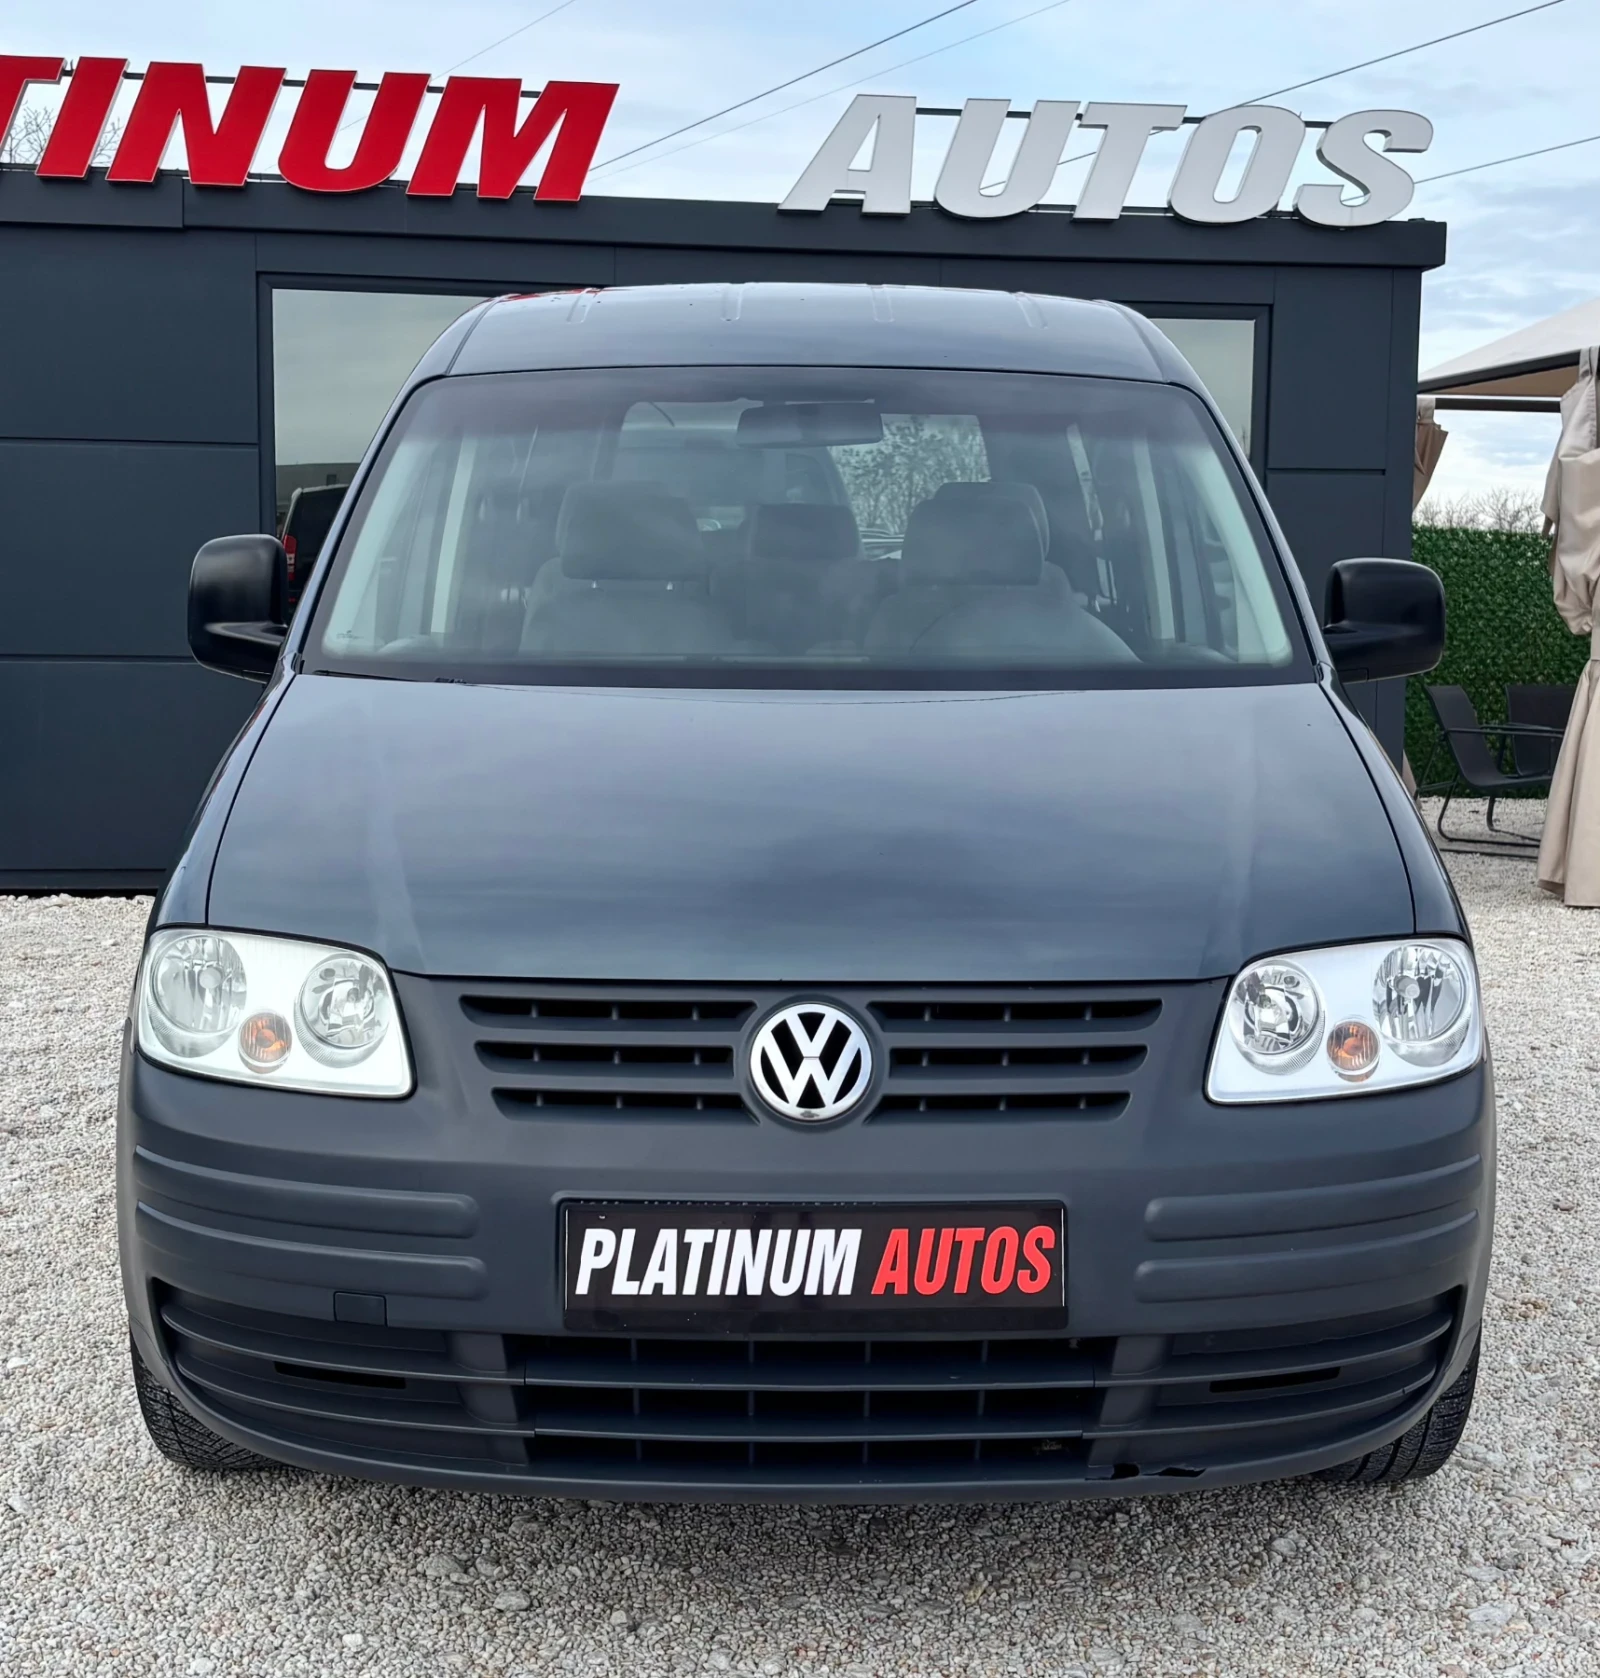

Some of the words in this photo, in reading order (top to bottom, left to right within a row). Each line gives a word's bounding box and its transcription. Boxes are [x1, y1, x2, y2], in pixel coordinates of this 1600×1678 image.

[777, 94, 1434, 228] AUTOS
[750, 1003, 872, 1121] VW
[575, 1228, 862, 1296] PLATINUM
[871, 1226, 1056, 1295] AUTOS
